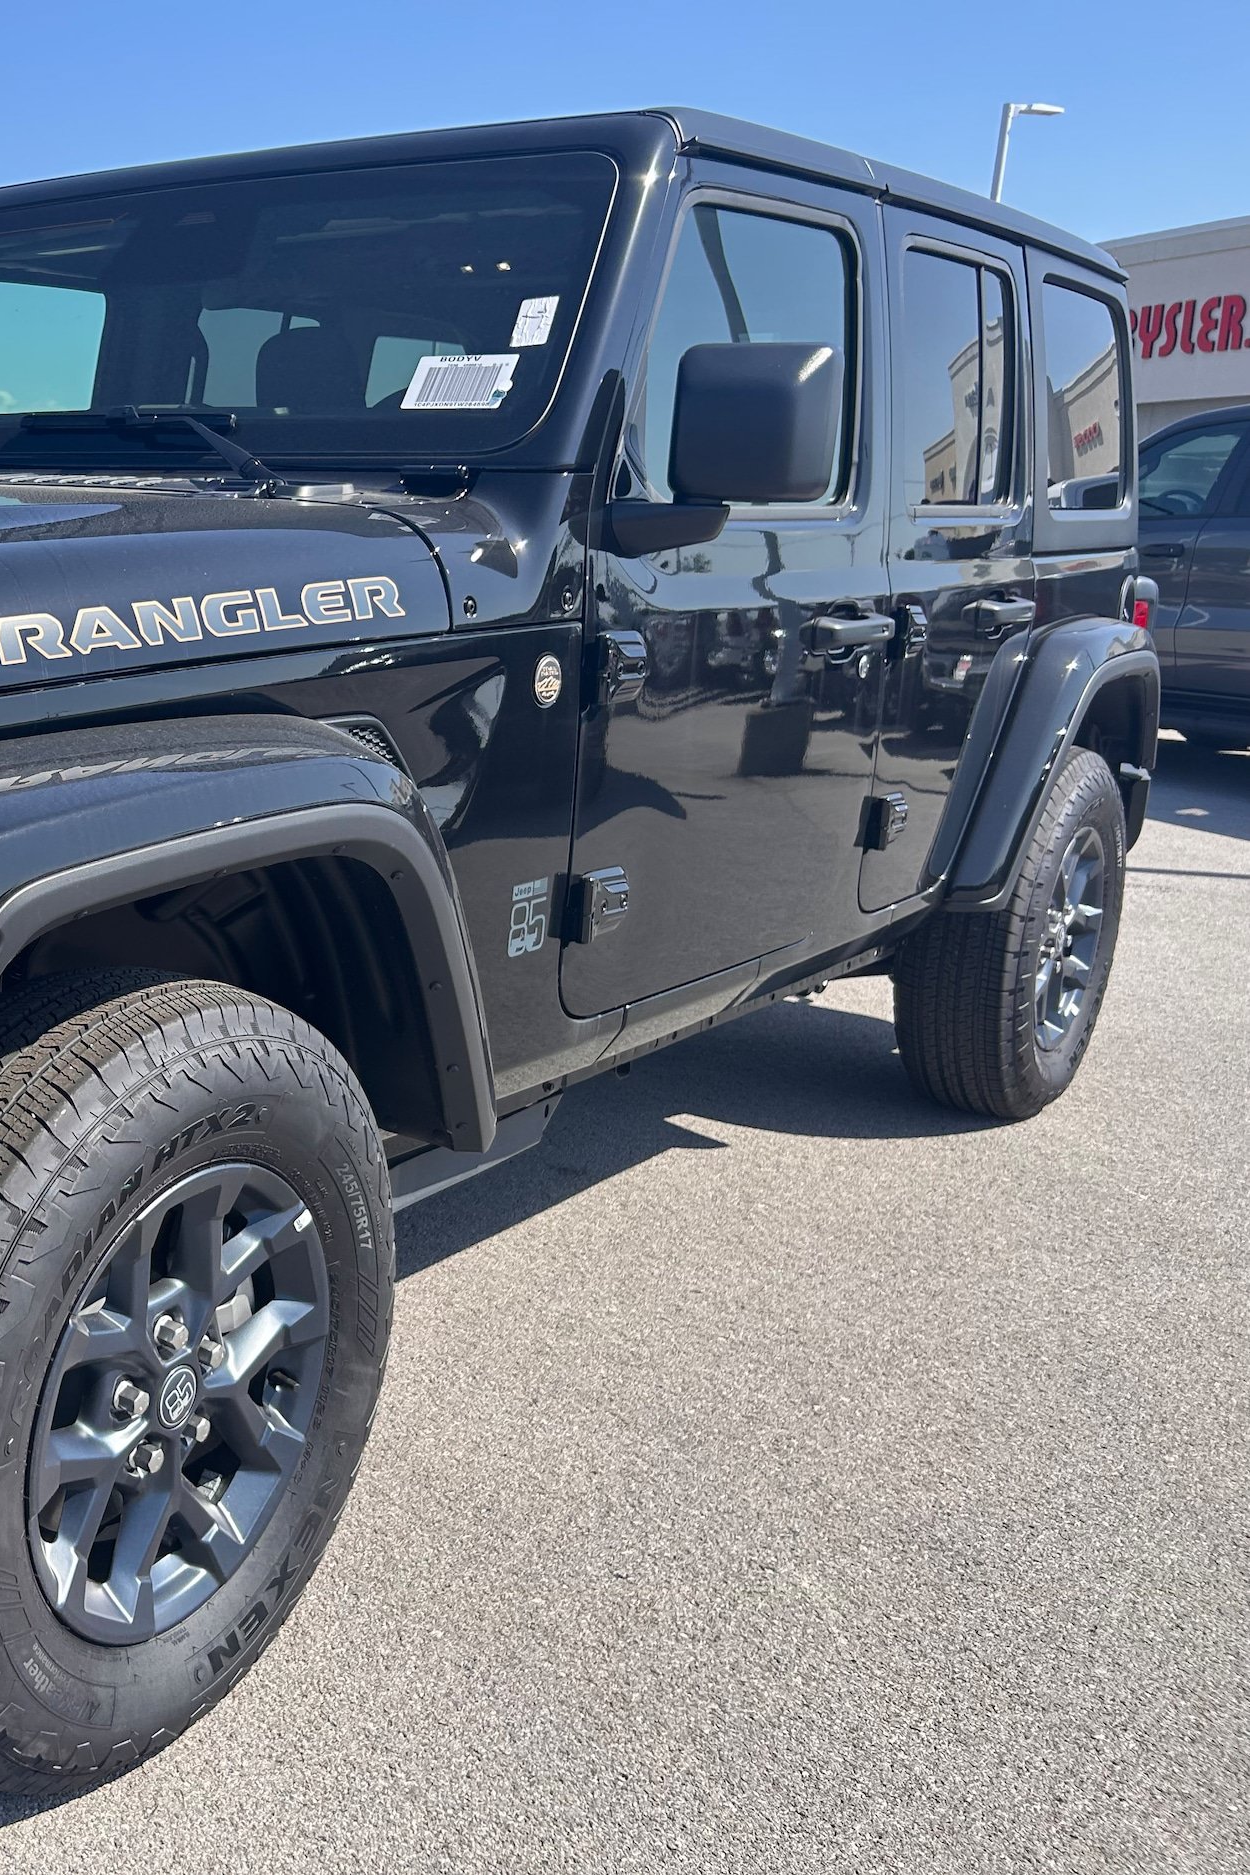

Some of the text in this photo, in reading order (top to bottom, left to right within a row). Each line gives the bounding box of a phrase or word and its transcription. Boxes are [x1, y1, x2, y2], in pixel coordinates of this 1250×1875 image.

[514, 886, 532, 897] Jeep
[508, 896, 547, 957] 85
[335, 1162, 373, 1249] 245/75R17
[165, 1374, 194, 1420] 85
[207, 1477, 338, 1675] NEXEN
